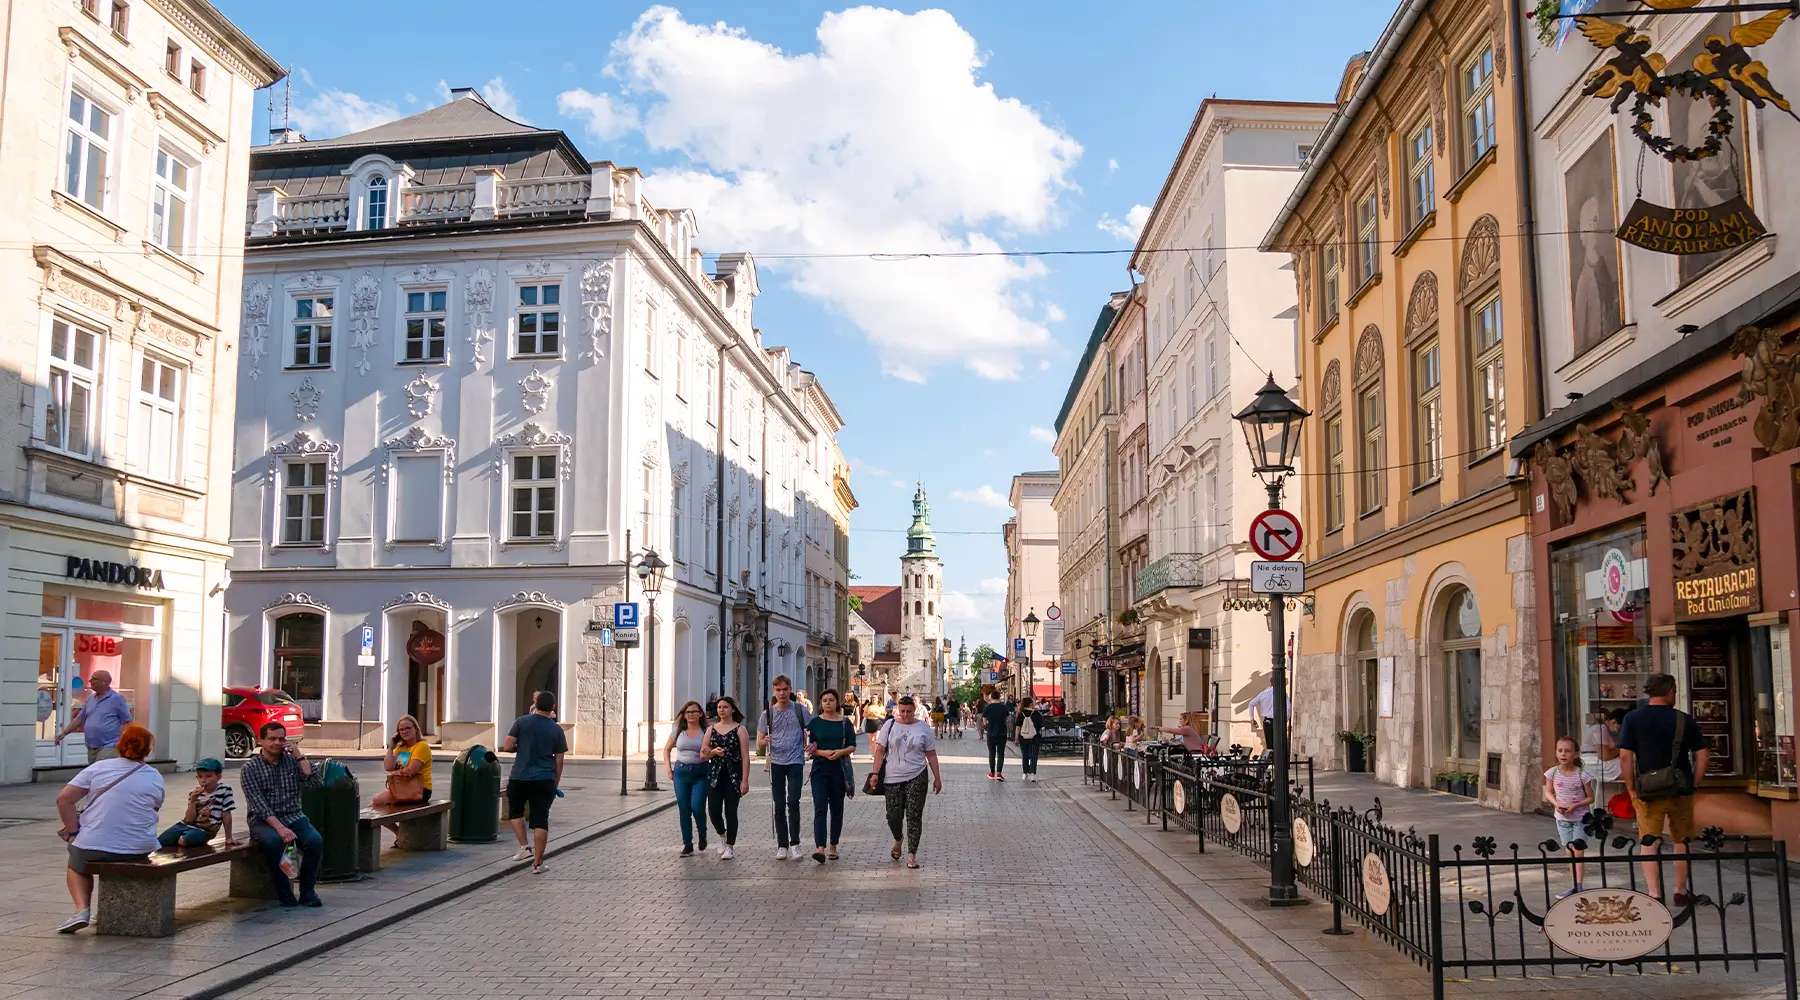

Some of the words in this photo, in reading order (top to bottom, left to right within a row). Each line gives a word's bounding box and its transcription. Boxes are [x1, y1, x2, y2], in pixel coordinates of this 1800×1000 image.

[1673, 209, 1709, 222] POD
[67, 556, 165, 592] PANDORA
[1676, 567, 1756, 600] RESTAURACJA
[619, 605, 634, 625] P
[1687, 599, 1705, 616] Pod
[364, 628, 372, 641] P
[78, 634, 115, 653] Sale
[1016, 639, 1025, 650] P
[1567, 930, 1591, 938] POD
